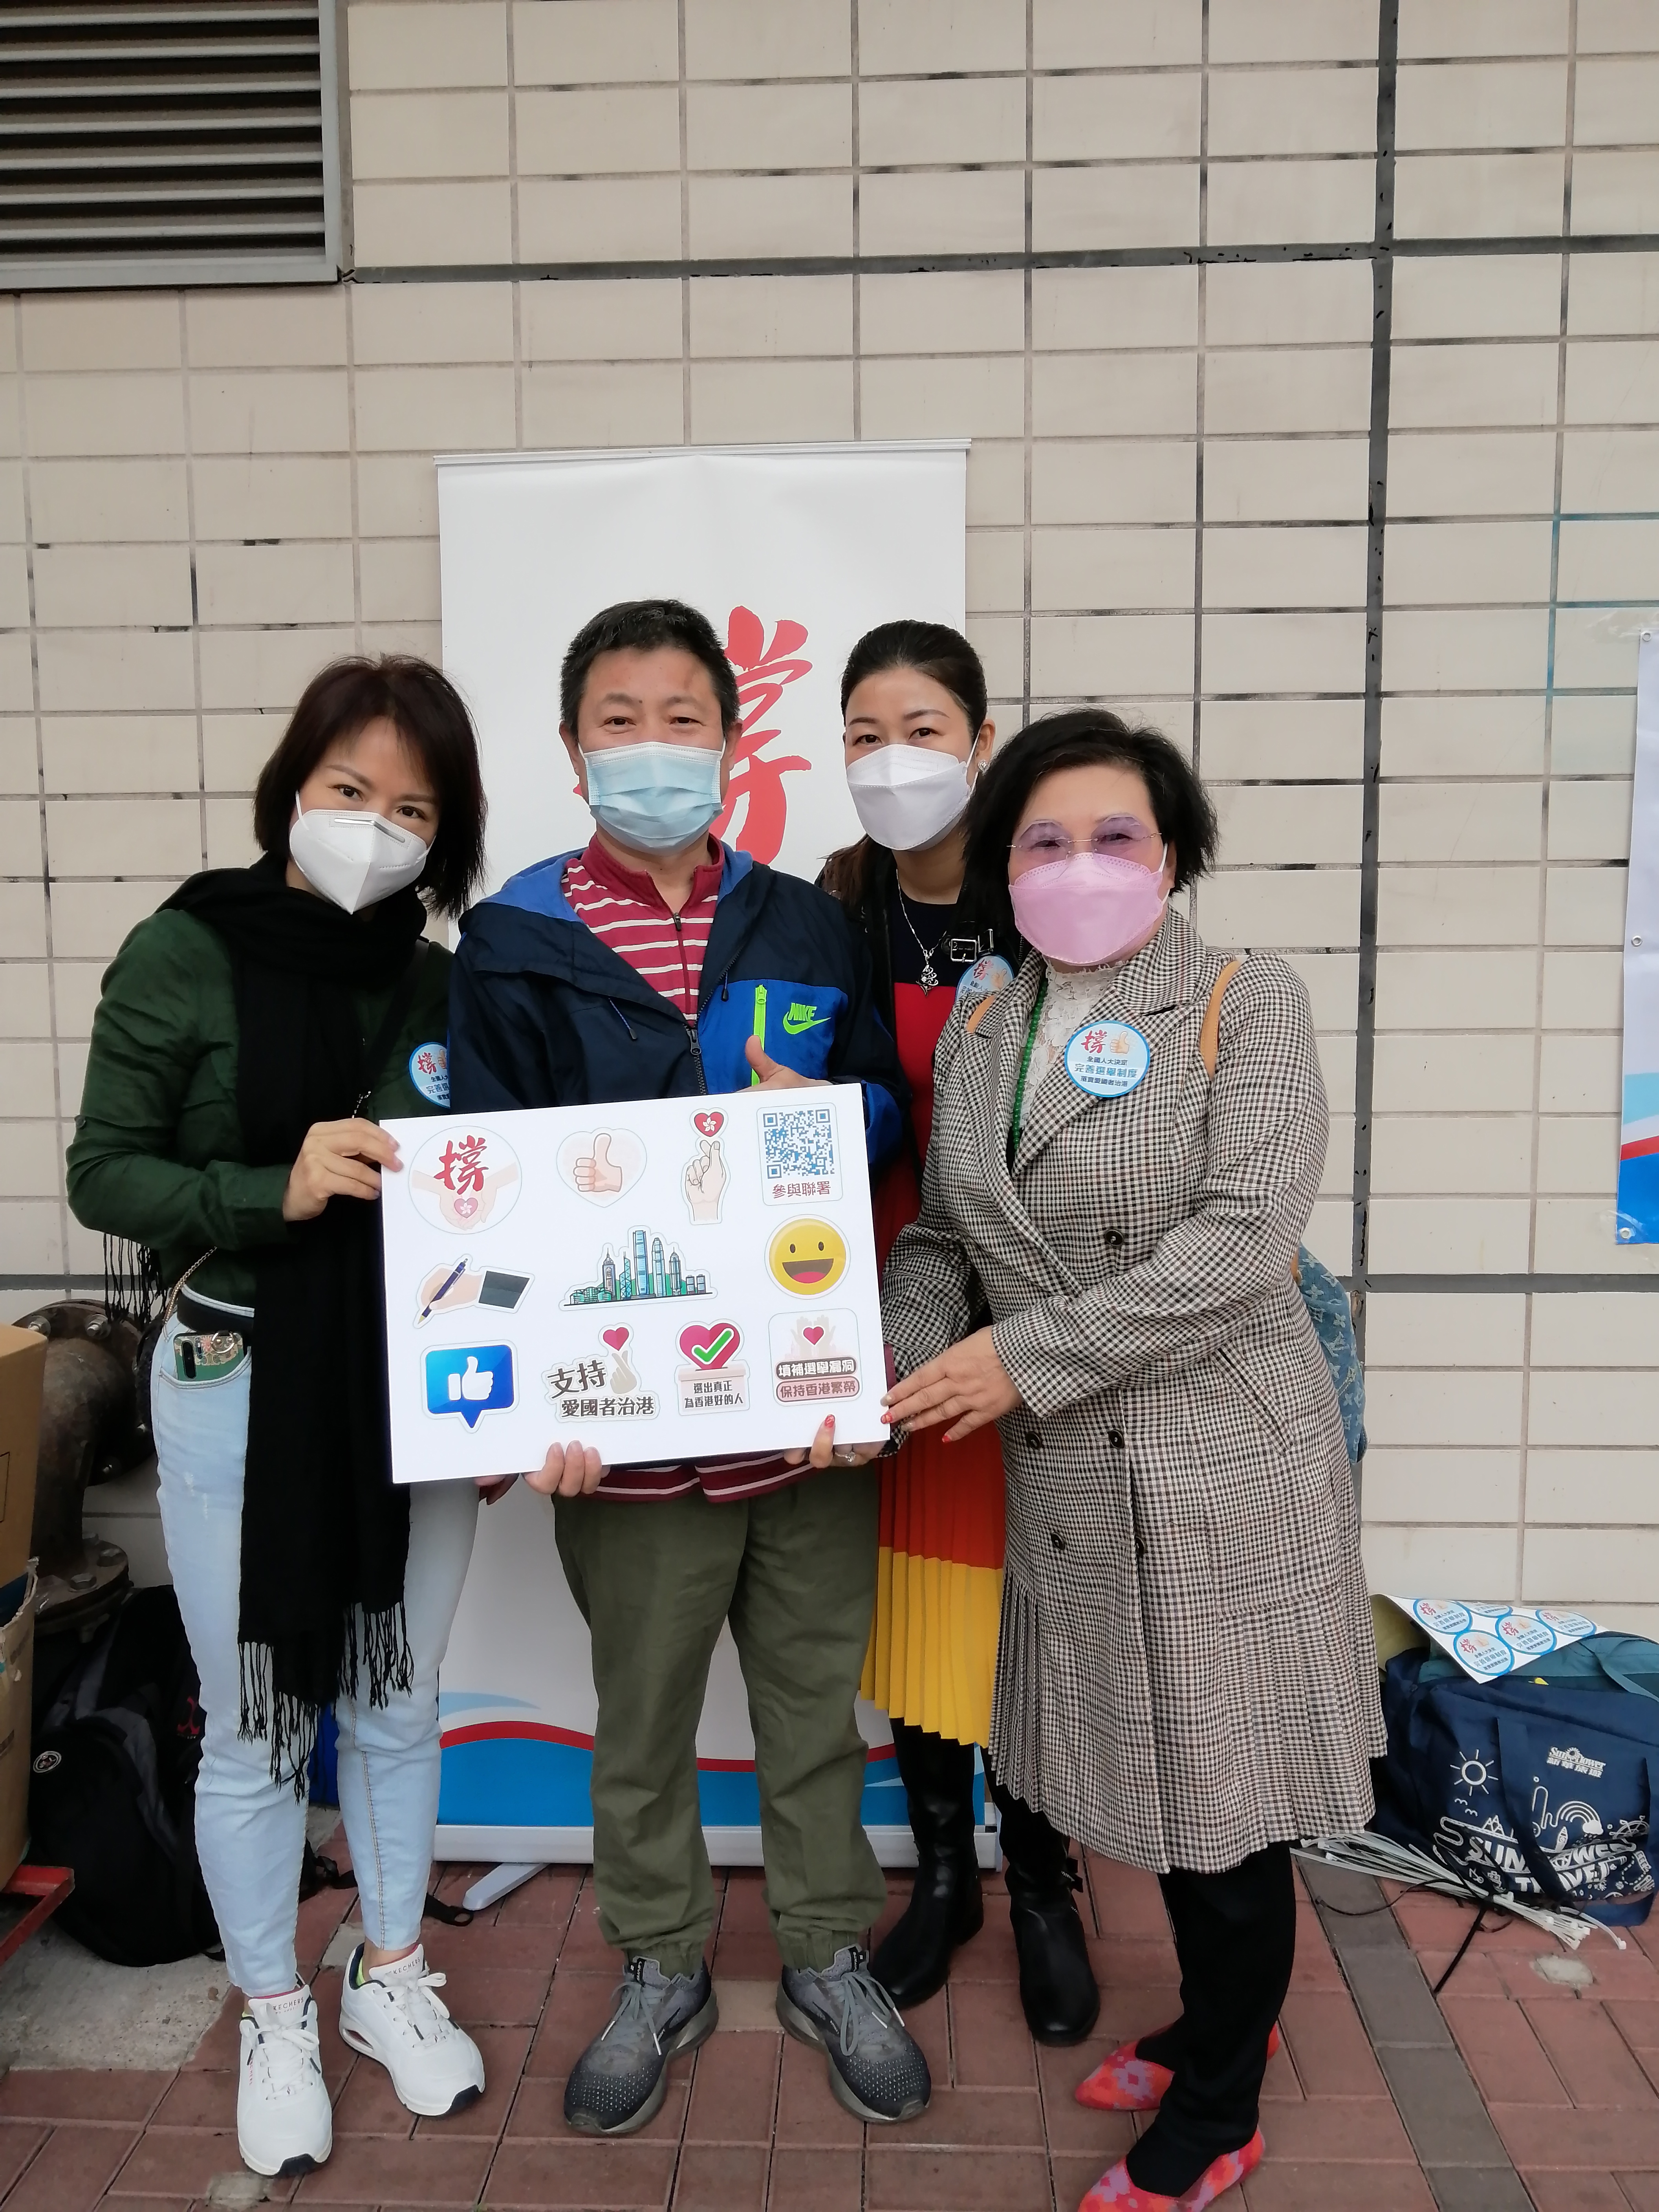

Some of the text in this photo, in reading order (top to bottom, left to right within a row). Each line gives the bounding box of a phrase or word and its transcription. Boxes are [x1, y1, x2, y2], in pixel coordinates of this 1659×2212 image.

[788, 1002, 818, 1021] NIKE
[1080, 1029, 1108, 1053] 撐
[417, 1052, 437, 1075] 撐
[1087, 1056, 1128, 1066] 全國人大決定
[1074, 1063, 1138, 1078] 完善選舉制度
[434, 1135, 489, 1195] 撐
[772, 1181, 831, 1199] 參與聯署
[778, 1359, 854, 1377] 填補選舉漏洞
[547, 1359, 606, 1399] 支持
[694, 1380, 732, 1394] 選出真正
[780, 1380, 856, 1398] 保持香港繁榮
[561, 1396, 655, 1417] 愛國者治港
[393, 1957, 420, 1974] KECHERS
[273, 1997, 304, 2011] KECHERS
